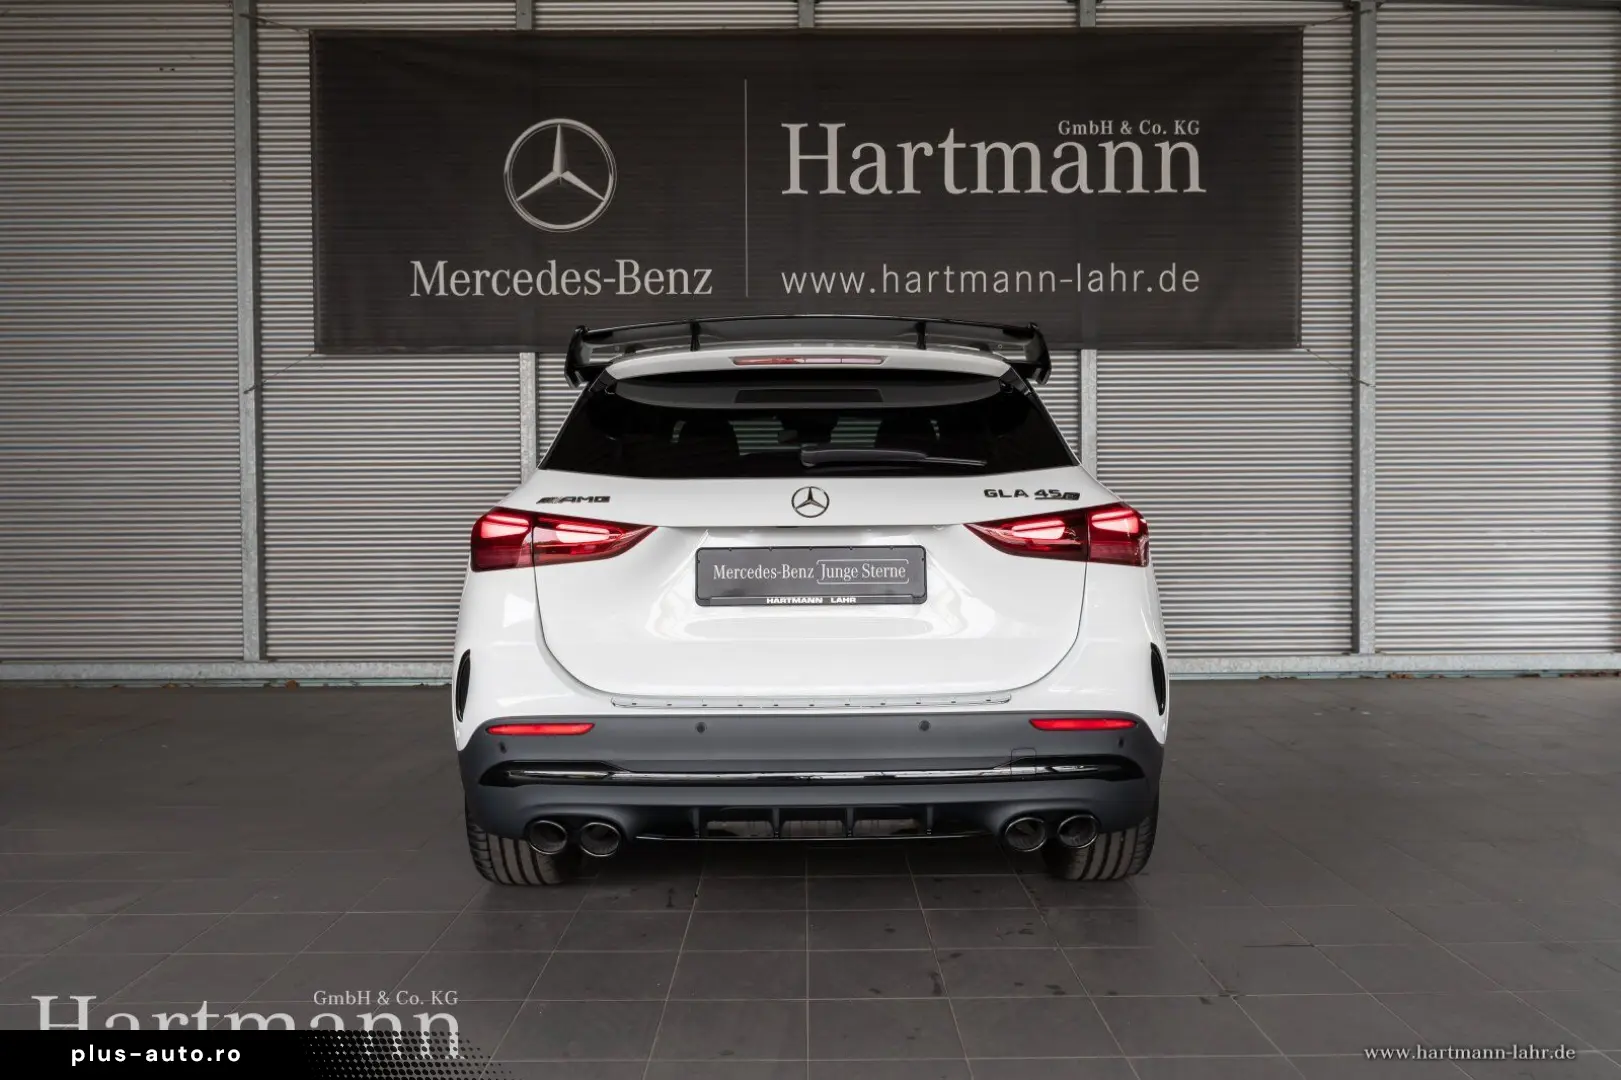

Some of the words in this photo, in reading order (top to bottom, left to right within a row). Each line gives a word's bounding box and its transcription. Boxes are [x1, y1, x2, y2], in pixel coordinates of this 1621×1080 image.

[1058, 120, 1113, 135] GmbH
[1120, 120, 1132, 135] &
[1139, 120, 1167, 135] Co.
[1174, 120, 1200, 135] KG
[781, 121, 1207, 195] Hartmann
[410, 259, 713, 297] Mercedes-Benz
[781, 262, 1200, 294] www.hartmann-lahr.de
[983, 488, 1029, 499] GLA
[713, 563, 815, 580] Mercedes-Benz
[821, 563, 859, 582] Junge
[861, 562, 906, 579] Sterne
[766, 596, 823, 604] HARTMANN
[830, 596, 857, 604] LAHR
